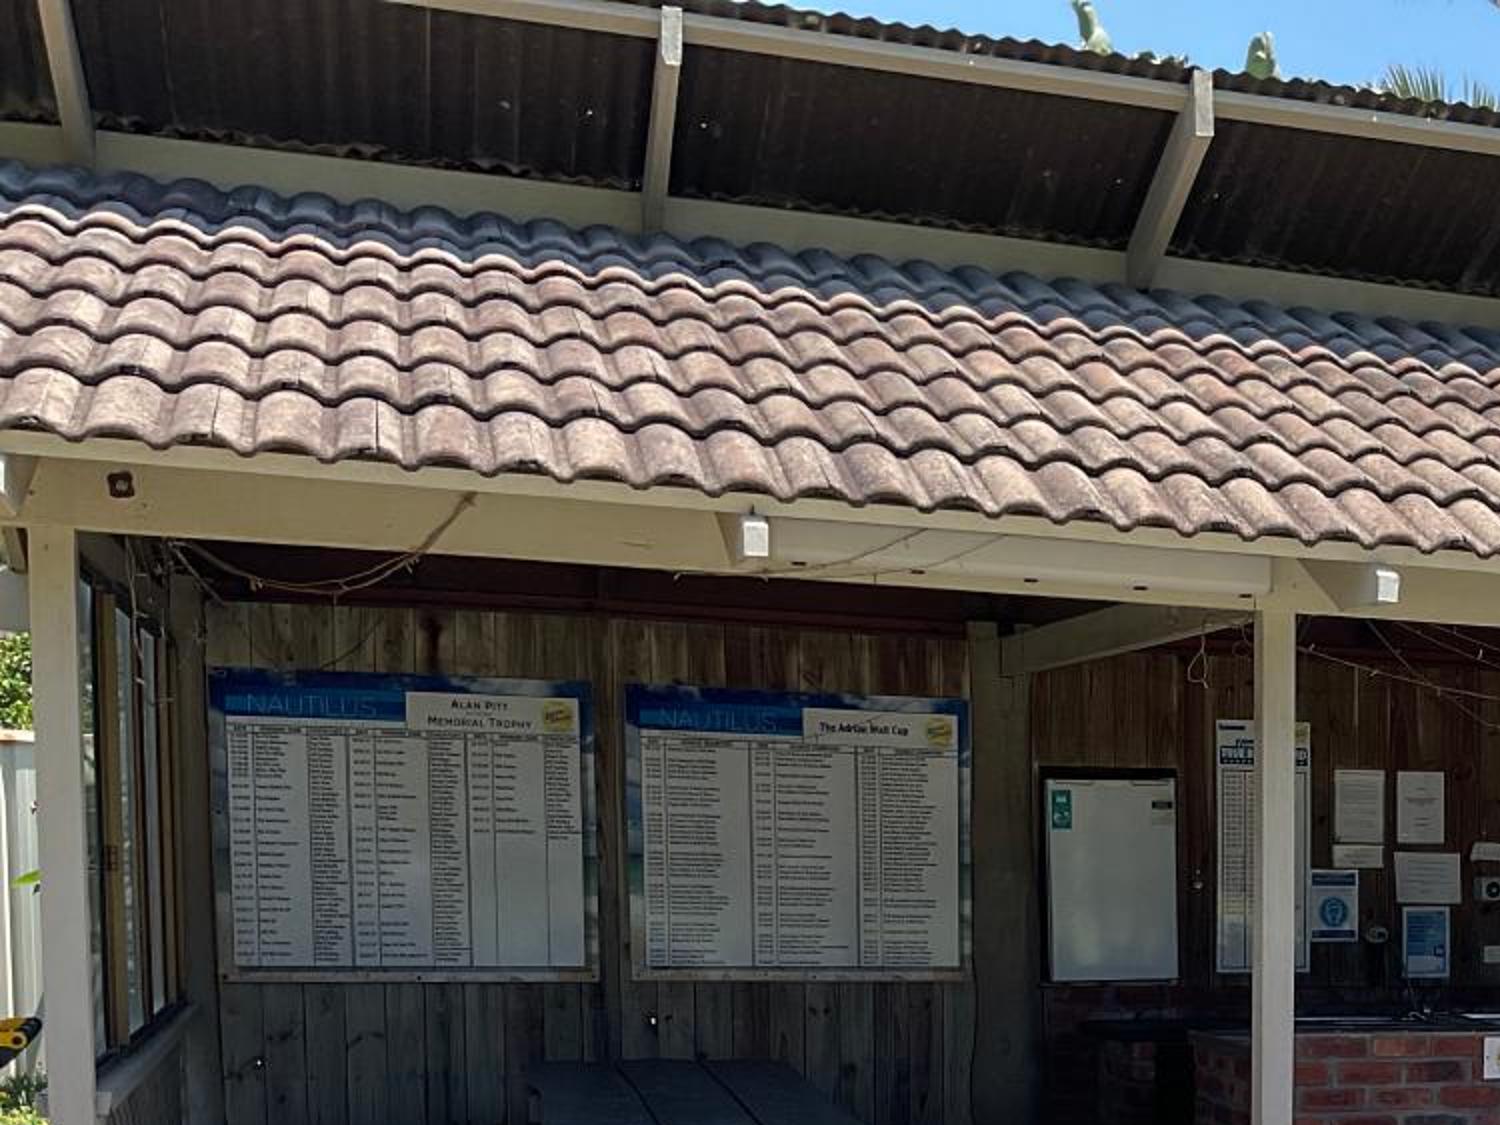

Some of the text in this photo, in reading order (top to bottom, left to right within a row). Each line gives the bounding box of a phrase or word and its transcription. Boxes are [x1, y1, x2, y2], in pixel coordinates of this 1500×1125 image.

[247, 694, 376, 717] NAUTILUS
[450, 699, 509, 712] ALAN PITT
[427, 715, 533, 730] MEMORIAL TROPHY
[819, 720, 836, 733] The
